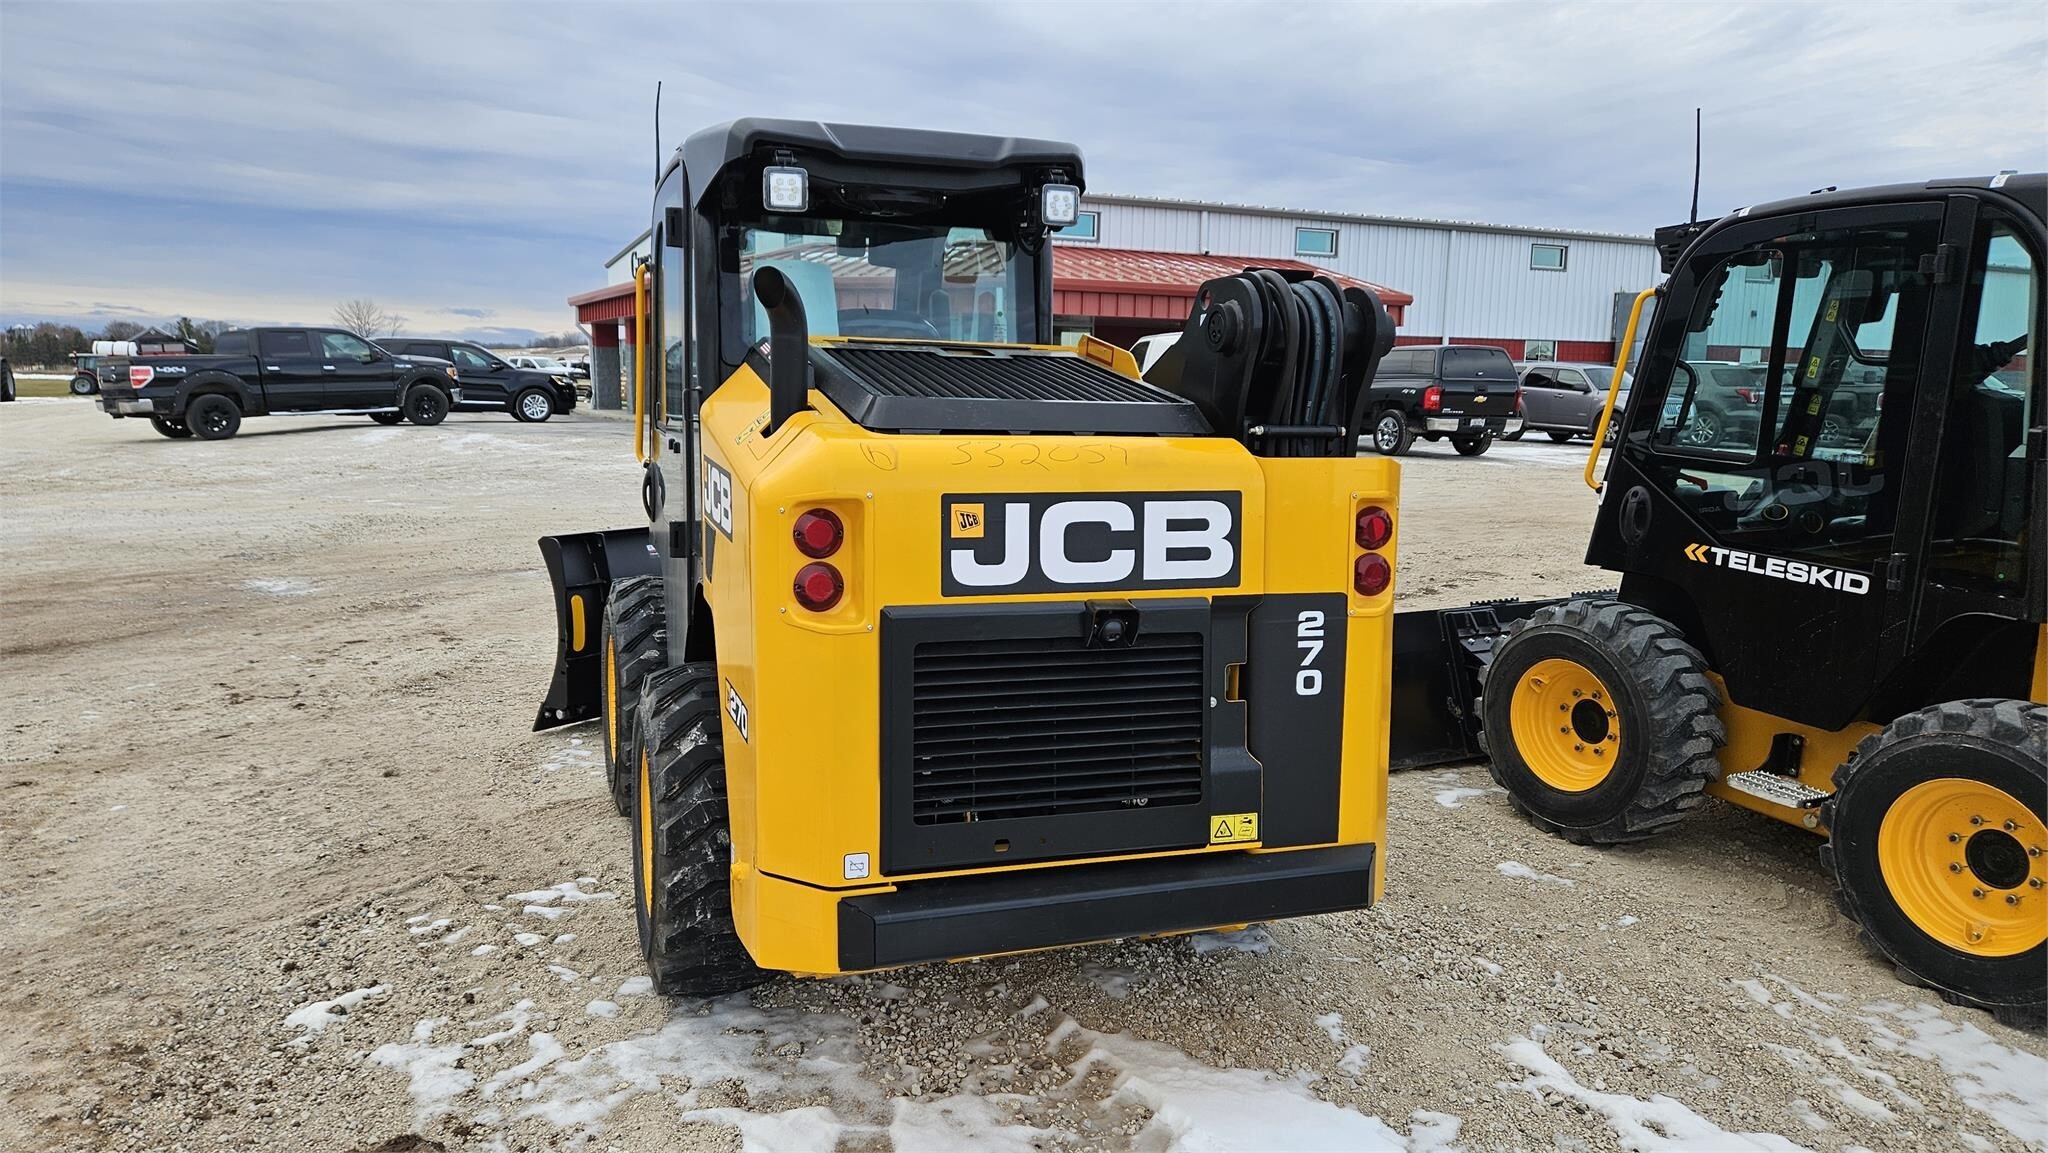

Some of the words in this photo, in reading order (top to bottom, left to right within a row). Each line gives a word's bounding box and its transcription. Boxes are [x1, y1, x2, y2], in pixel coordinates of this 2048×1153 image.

[704, 463, 731, 534] JCB
[960, 512, 979, 529] JCB
[950, 500, 1234, 587] JCB
[1711, 546, 1870, 595] TELESKID
[1296, 610, 1324, 696] 270
